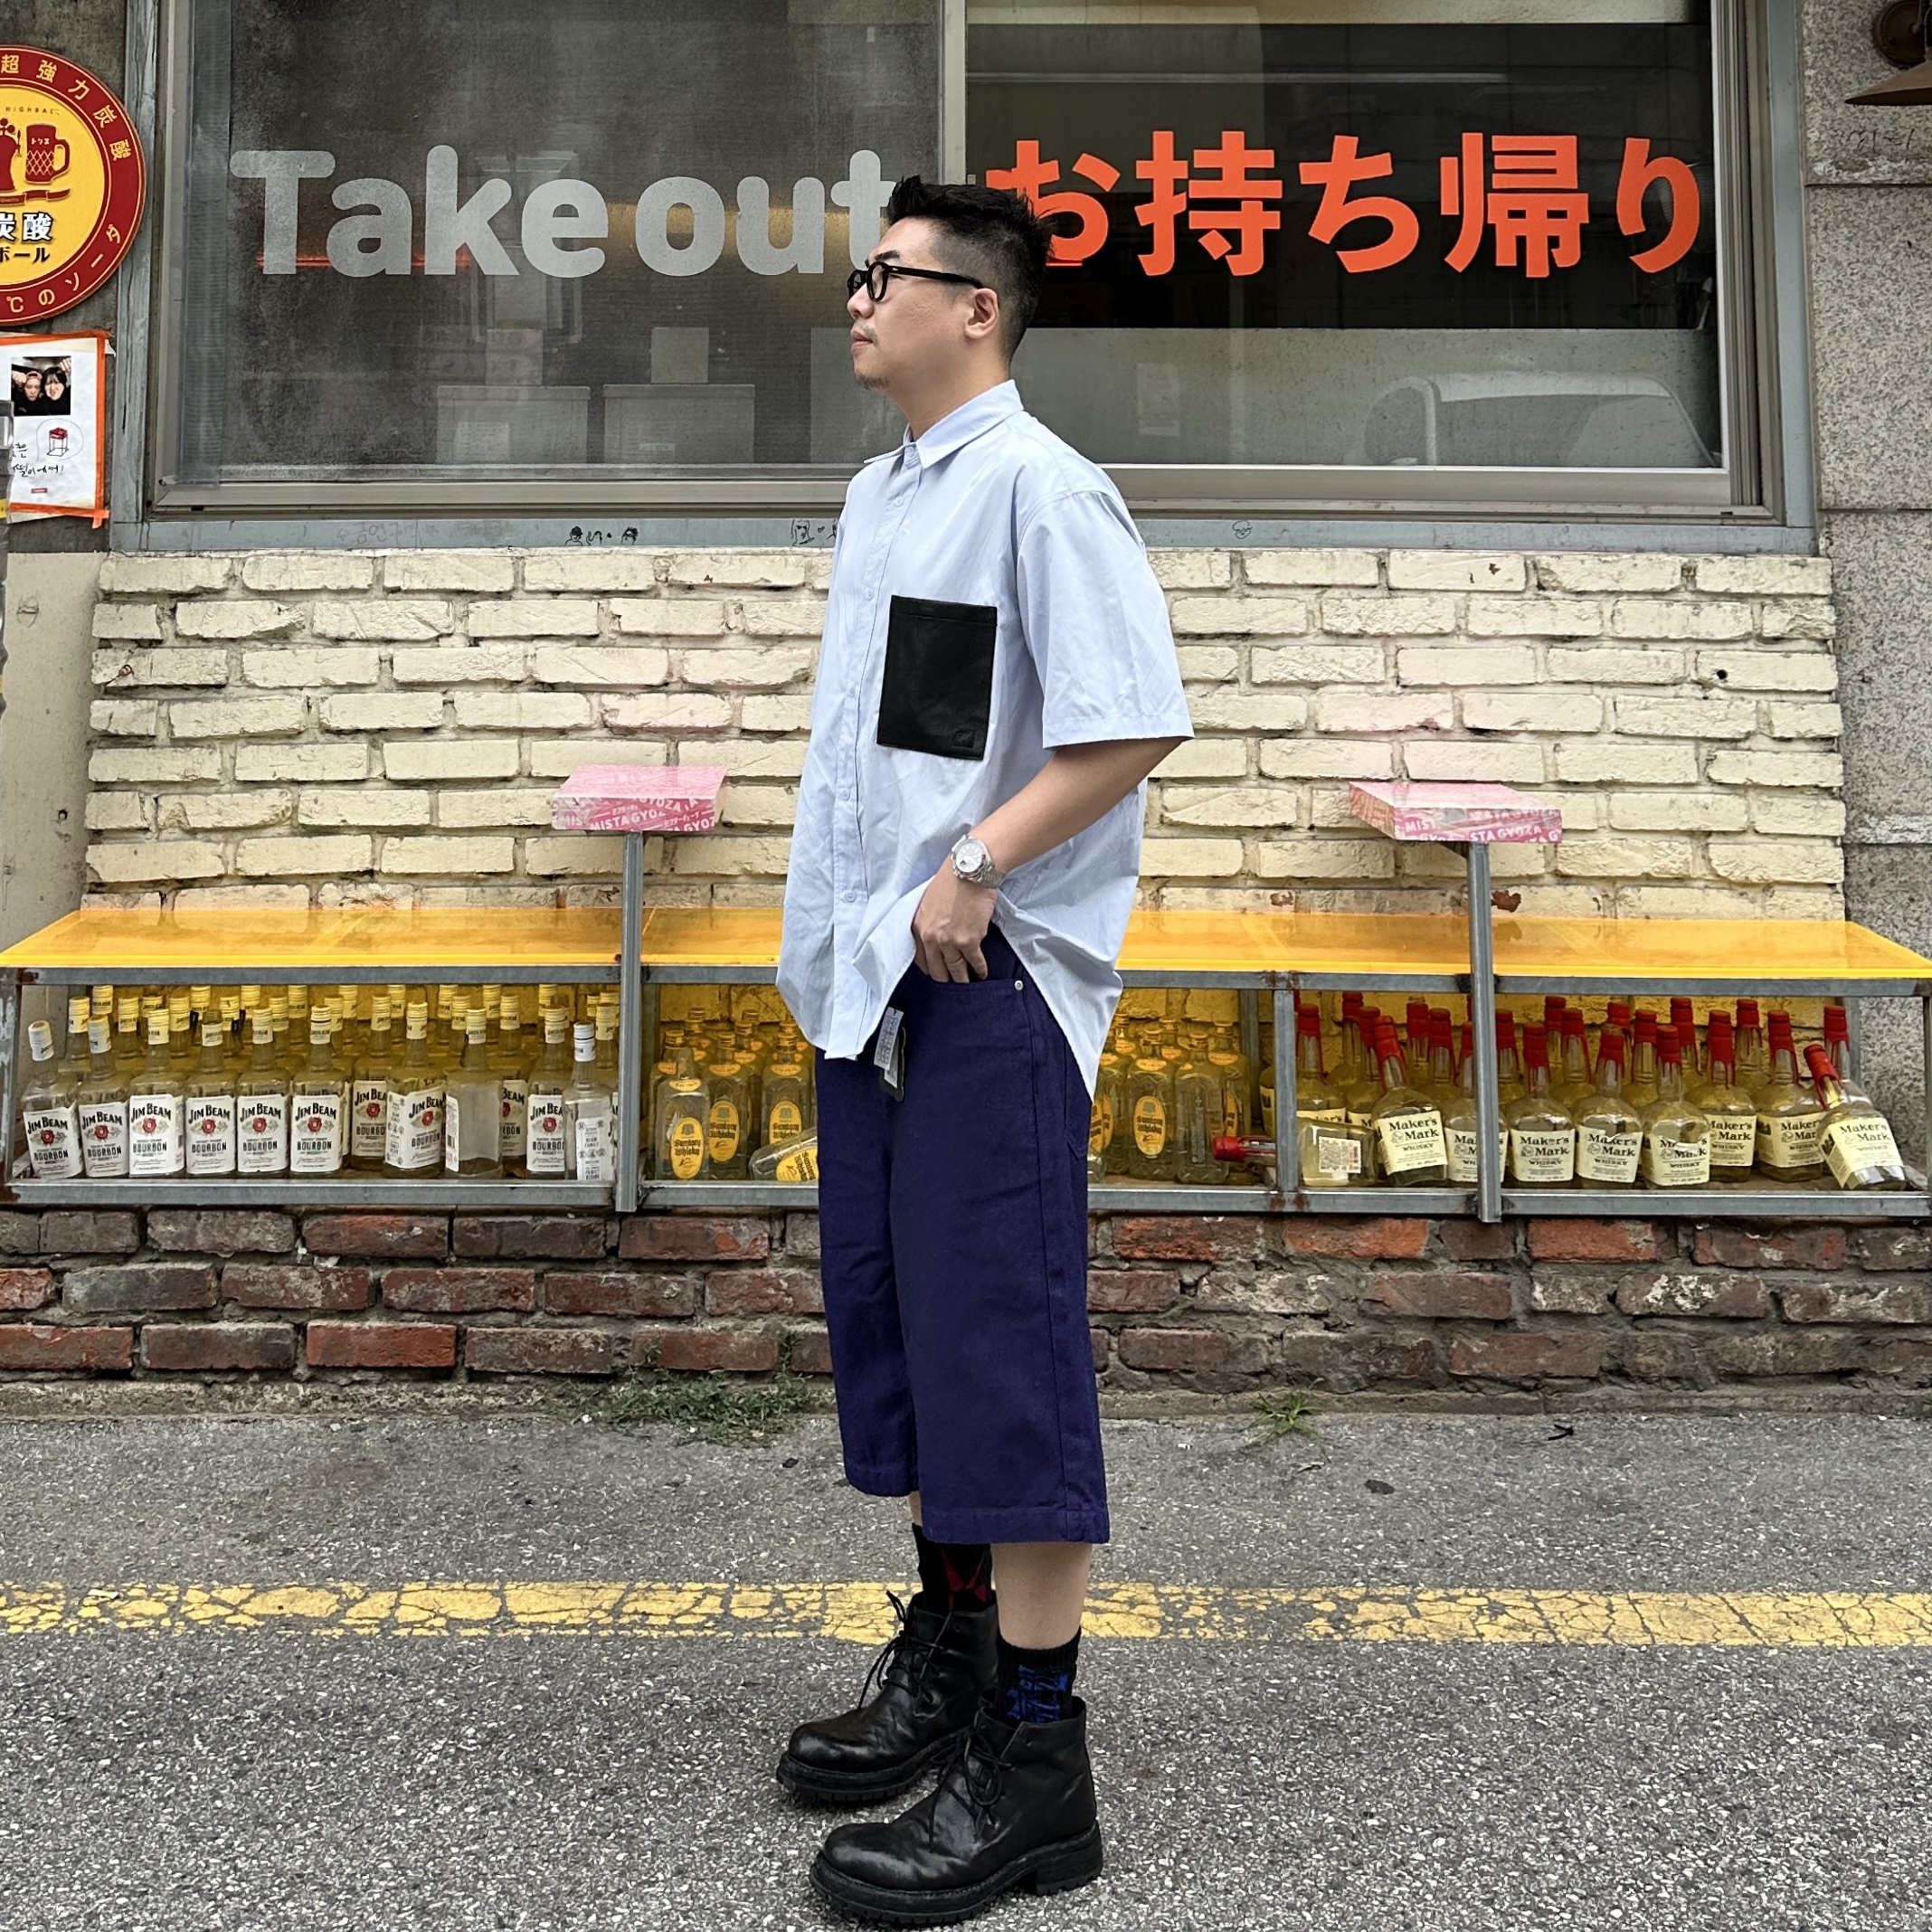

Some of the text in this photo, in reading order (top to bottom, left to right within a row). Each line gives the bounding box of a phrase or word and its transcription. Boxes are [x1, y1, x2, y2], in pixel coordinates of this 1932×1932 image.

[986, 130, 1700, 278] お持ち帰り
[230, 145, 898, 279] Take out
[590, 814, 630, 830] MISTA
[355, 1088, 386, 1106] JIM BEA
[131, 1103, 172, 1122] JIM BEAM
[188, 1104, 231, 1124] JIM BEAM
[240, 1103, 281, 1122] JIM BEAM
[295, 1103, 336, 1121] JIM BEAM
[409, 1101, 425, 1118] JIM
[530, 1103, 563, 1121] JIM BEA
[27, 1116, 68, 1134] JIM BEAM
[81, 1112, 123, 1130] JIM BEAM
[1388, 1117, 1438, 1132] Maker's
[1781, 1120, 1821, 1131] Maker'
[356, 1126, 385, 1135] BOURBO
[1839, 1122, 1888, 1134] Maker's
[1405, 1129, 1440, 1141] Mark
[1719, 1131, 1752, 1141] Mark
[1795, 1131, 1816, 1141] Mar
[1857, 1132, 1891, 1142] Mark
[88, 1145, 122, 1158] BOURBON
[133, 1141, 167, 1153] BOURBON
[192, 1142, 226, 1153] BOURBON
[243, 1141, 278, 1151] BOURBON
[298, 1141, 332, 1151] BOURBON
[532, 1141, 564, 1151] BOURBO
[1535, 1146, 1570, 1156] Mark
[1602, 1146, 1636, 1157] Mark
[33, 1150, 69, 1161] BOURBON
